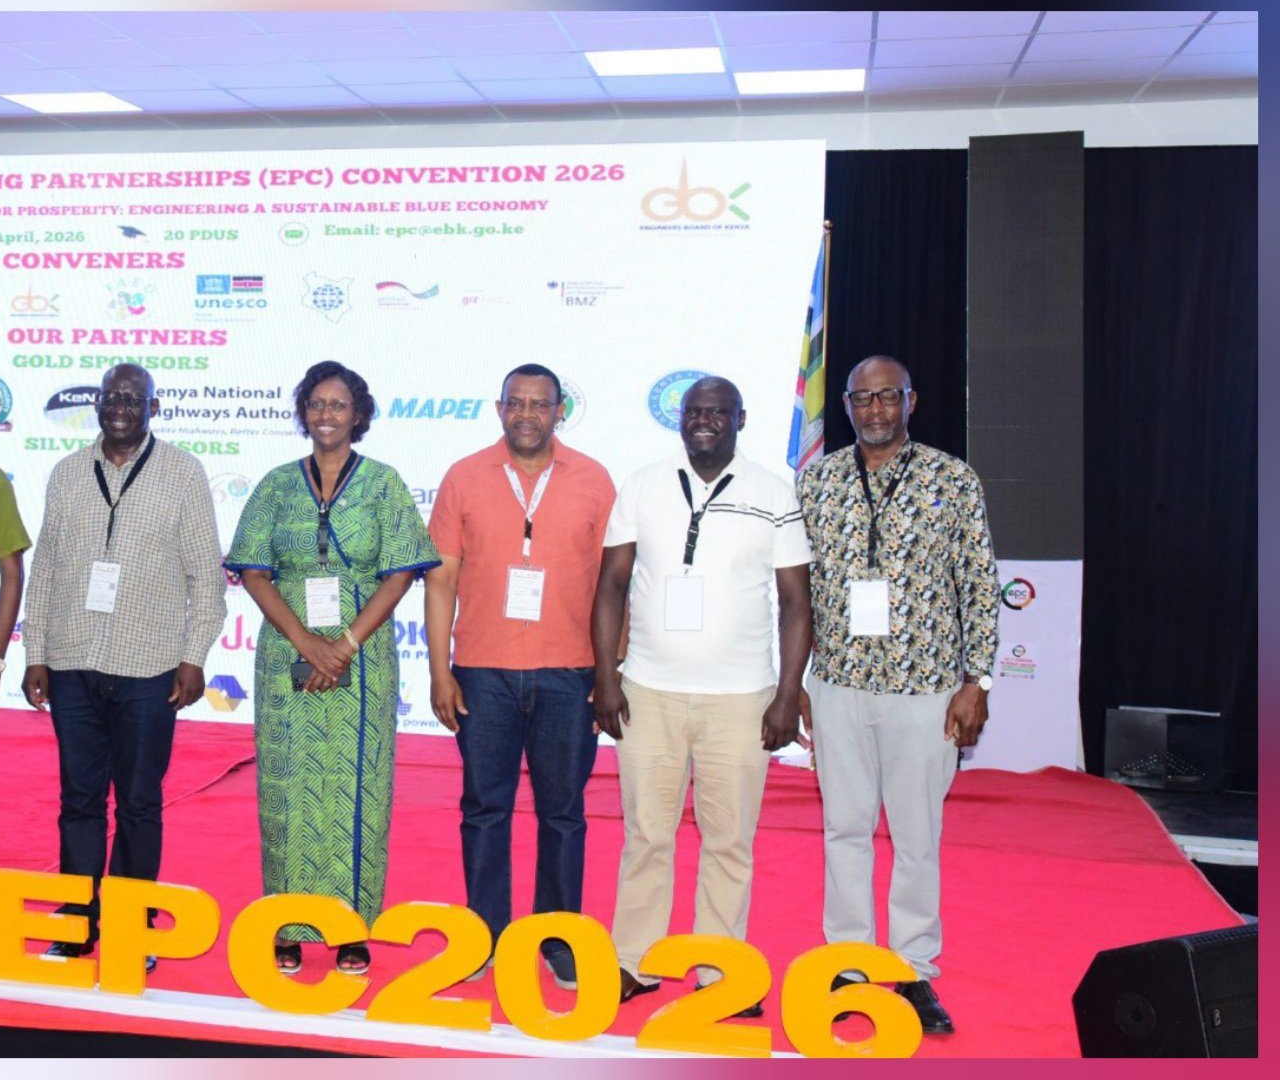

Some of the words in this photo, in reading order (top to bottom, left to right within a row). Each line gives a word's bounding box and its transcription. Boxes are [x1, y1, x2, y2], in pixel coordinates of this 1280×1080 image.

[30, 169, 251, 190] PARTNERSHIPS
[259, 168, 334, 190] (EPC)
[341, 165, 547, 185] CONVENTION
[554, 163, 626, 183] 2026
[16, 204, 125, 217] PROSPERITY:
[128, 203, 250, 216] ENGINEERING
[253, 203, 267, 214] A
[271, 201, 401, 214] SUSTAINABLE
[404, 200, 452, 213] BLUE
[456, 199, 549, 212] ECONOMY
[43, 230, 86, 244] 2026
[163, 228, 185, 241] 20
[188, 228, 240, 241] PDUS
[324, 224, 380, 236] Email:
[385, 222, 525, 238] epc@ebk.go.ke
[2, 251, 186, 270] CONVENERS
[194, 298, 268, 309] unesco
[565, 296, 598, 306] BMZ
[7, 328, 63, 345] OUR
[71, 328, 228, 346] PARTNERS
[12, 354, 74, 369] GOLD
[203, 386, 282, 399] National
[387, 397, 484, 420] MAPEI
